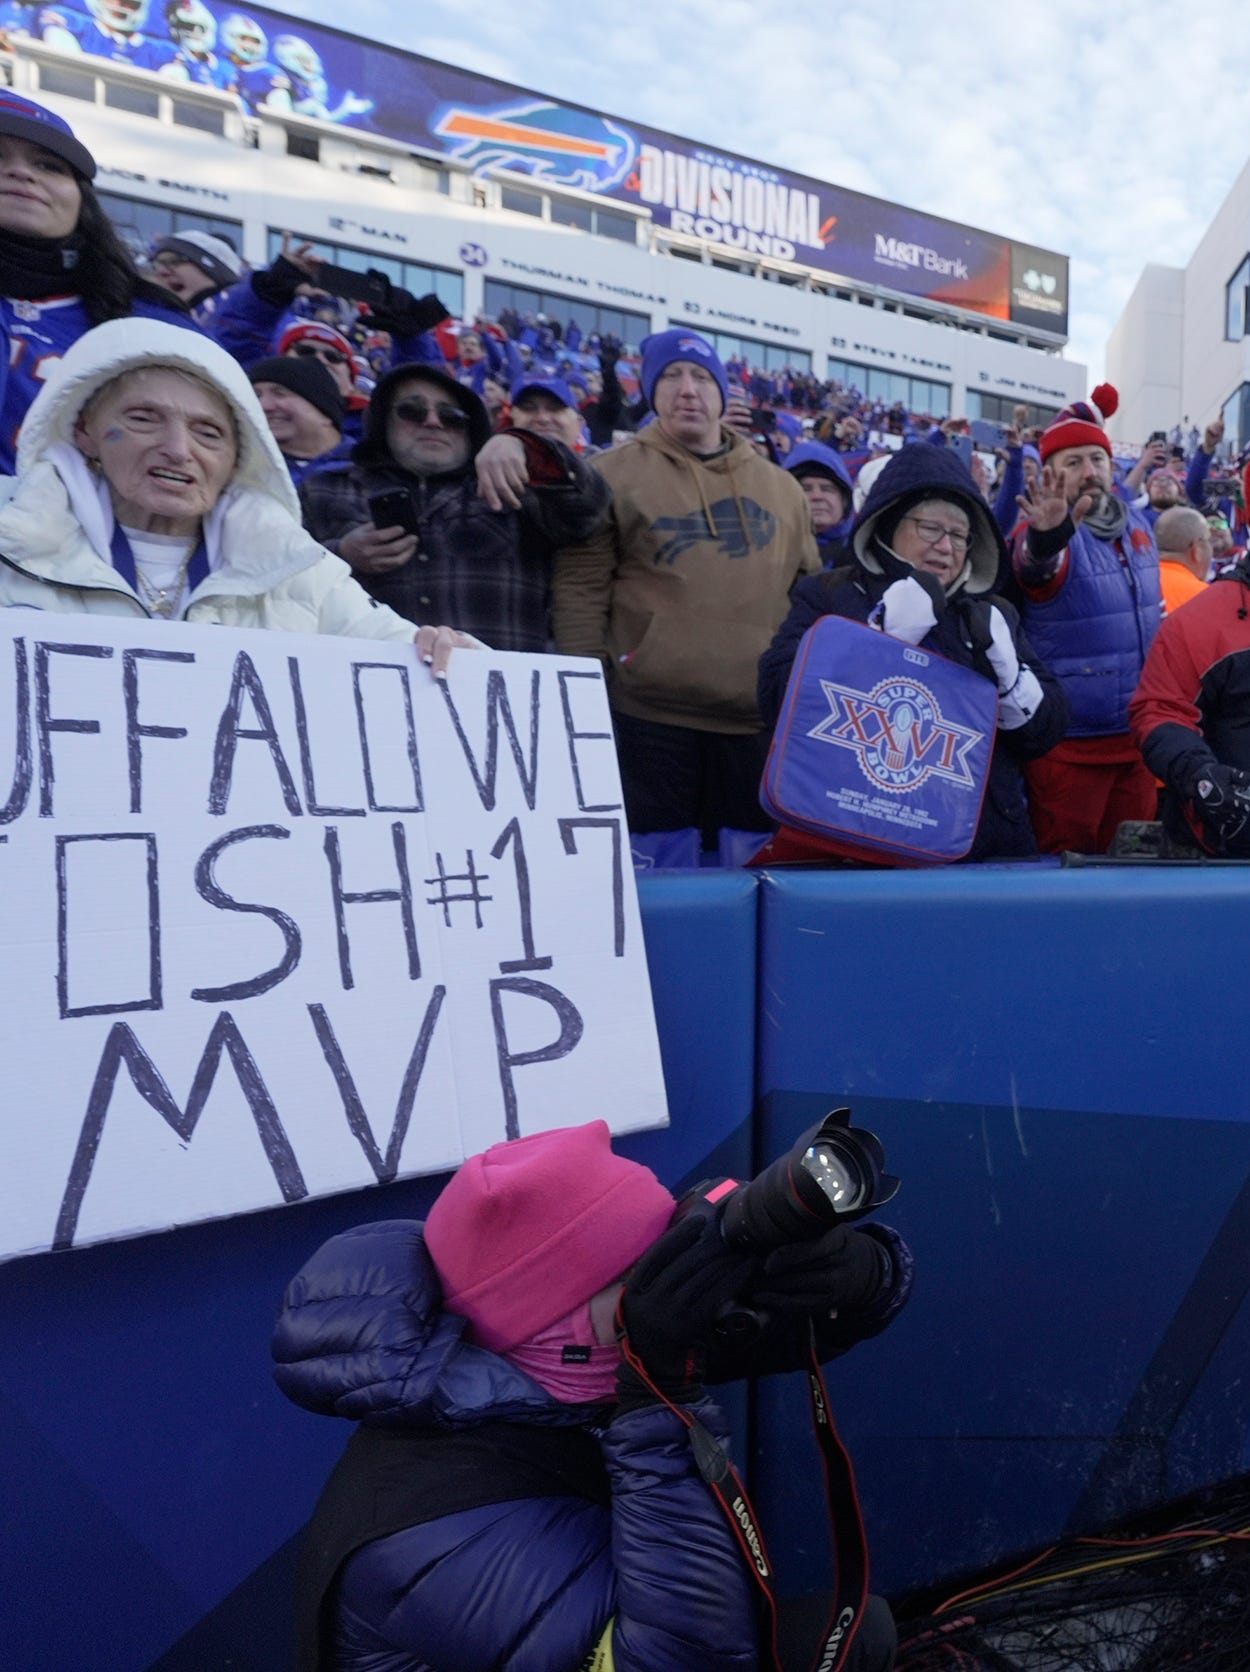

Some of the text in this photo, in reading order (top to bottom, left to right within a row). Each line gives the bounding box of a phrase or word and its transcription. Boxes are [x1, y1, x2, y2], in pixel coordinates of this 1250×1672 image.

[640, 143, 826, 250] DIVISIONAL
[361, 225, 408, 244] MAN
[670, 209, 797, 262] ROUND
[874, 233, 924, 267] M&T
[922, 249, 970, 281] Bank
[501, 258, 590, 286] THURMAN
[596, 282, 668, 304] THOMAS
[877, 686, 933, 721] SUPER
[832, 696, 961, 770] XXVI
[867, 751, 923, 784] BOWL
[0, 821, 423, 1020] OSH
[51, 976, 585, 1252] MVP
[732, 1496, 770, 1578] Canon
